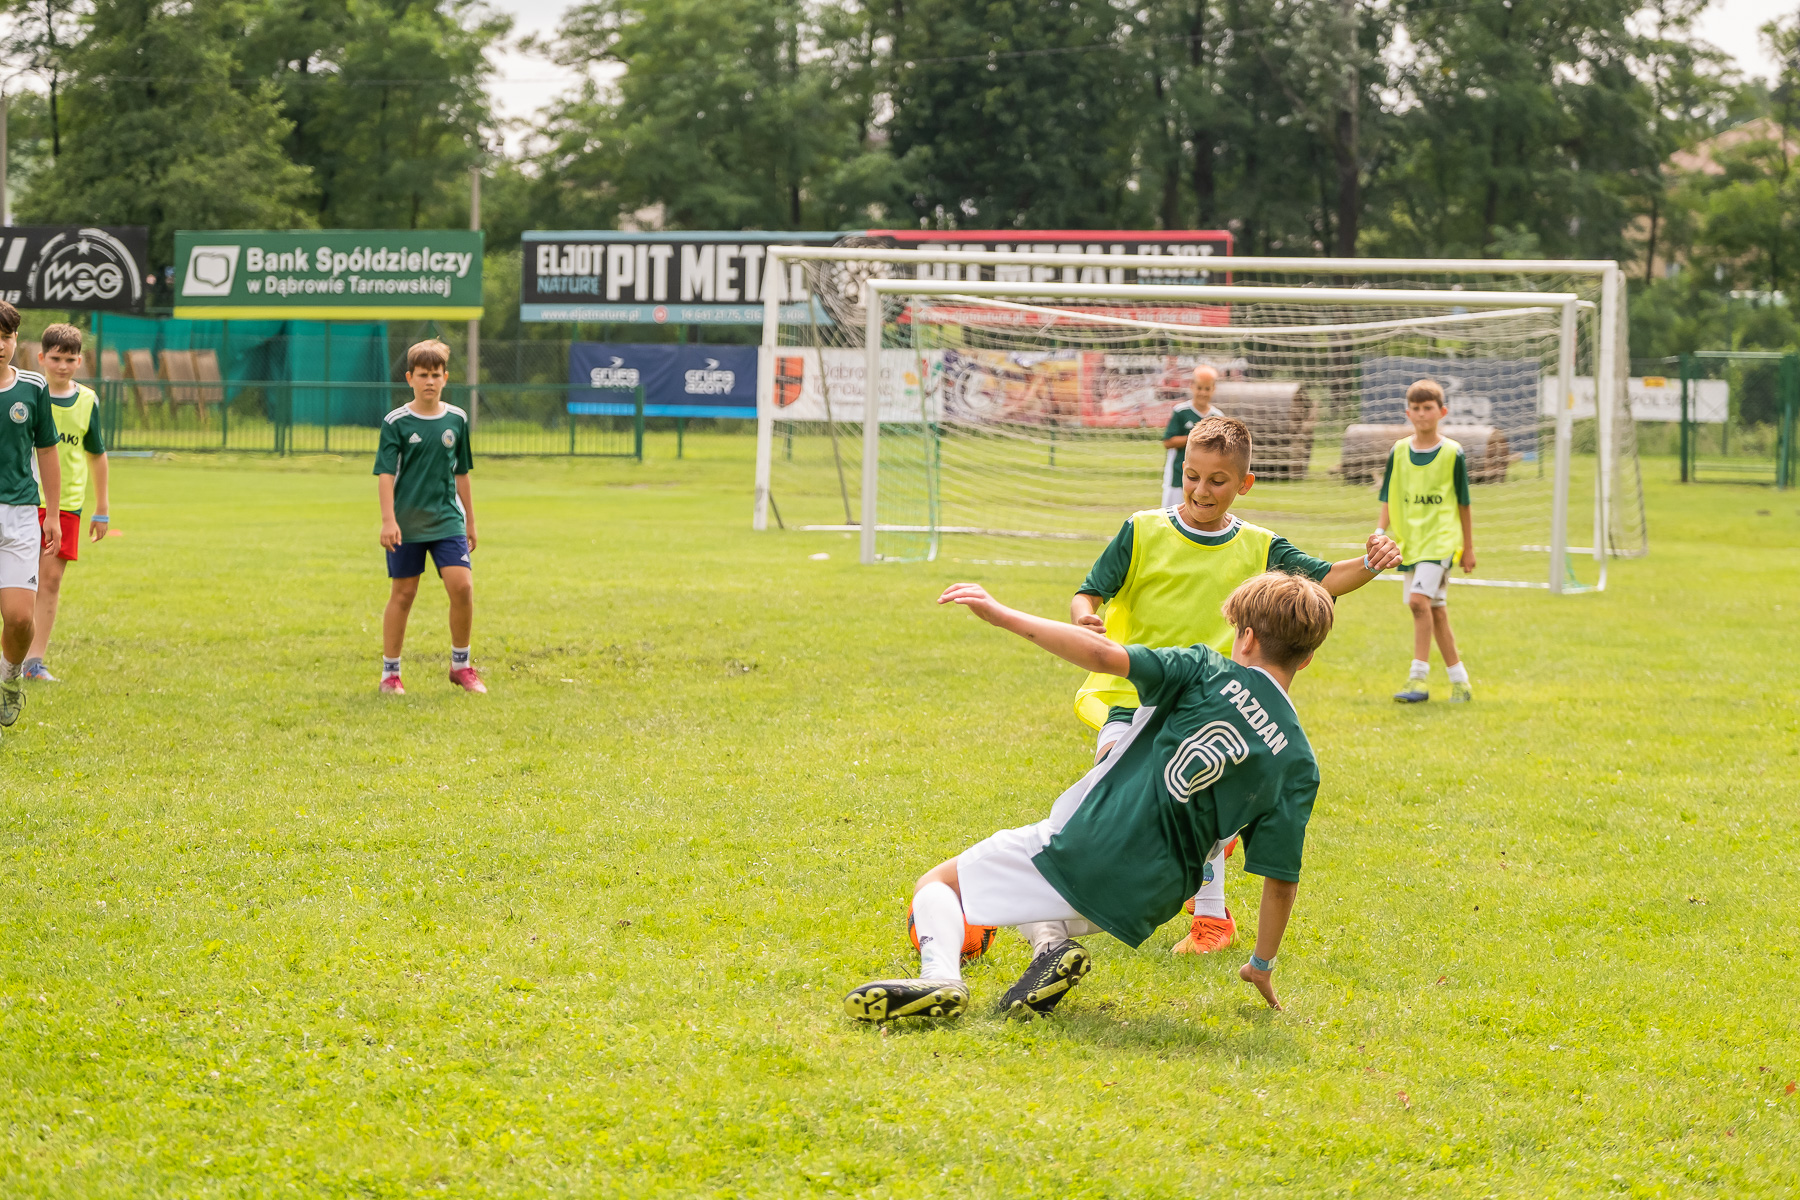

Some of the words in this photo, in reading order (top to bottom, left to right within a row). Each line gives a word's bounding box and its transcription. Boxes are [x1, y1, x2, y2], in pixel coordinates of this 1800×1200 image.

[246, 247, 310, 272] Bank
[315, 246, 473, 277] Spółdzielczy
[536, 244, 606, 276] ELJOT
[606, 244, 675, 301] PIT
[247, 279, 262, 294] w
[265, 276, 345, 298] Dąbrowie
[348, 276, 452, 298] Tarnowskiej
[536, 276, 601, 296] NATURE
[59, 432, 79, 446] AKO
[1414, 494, 1443, 505] JAKO
[1219, 679, 1289, 756] PAZDAN
[1164, 720, 1250, 804] 6
